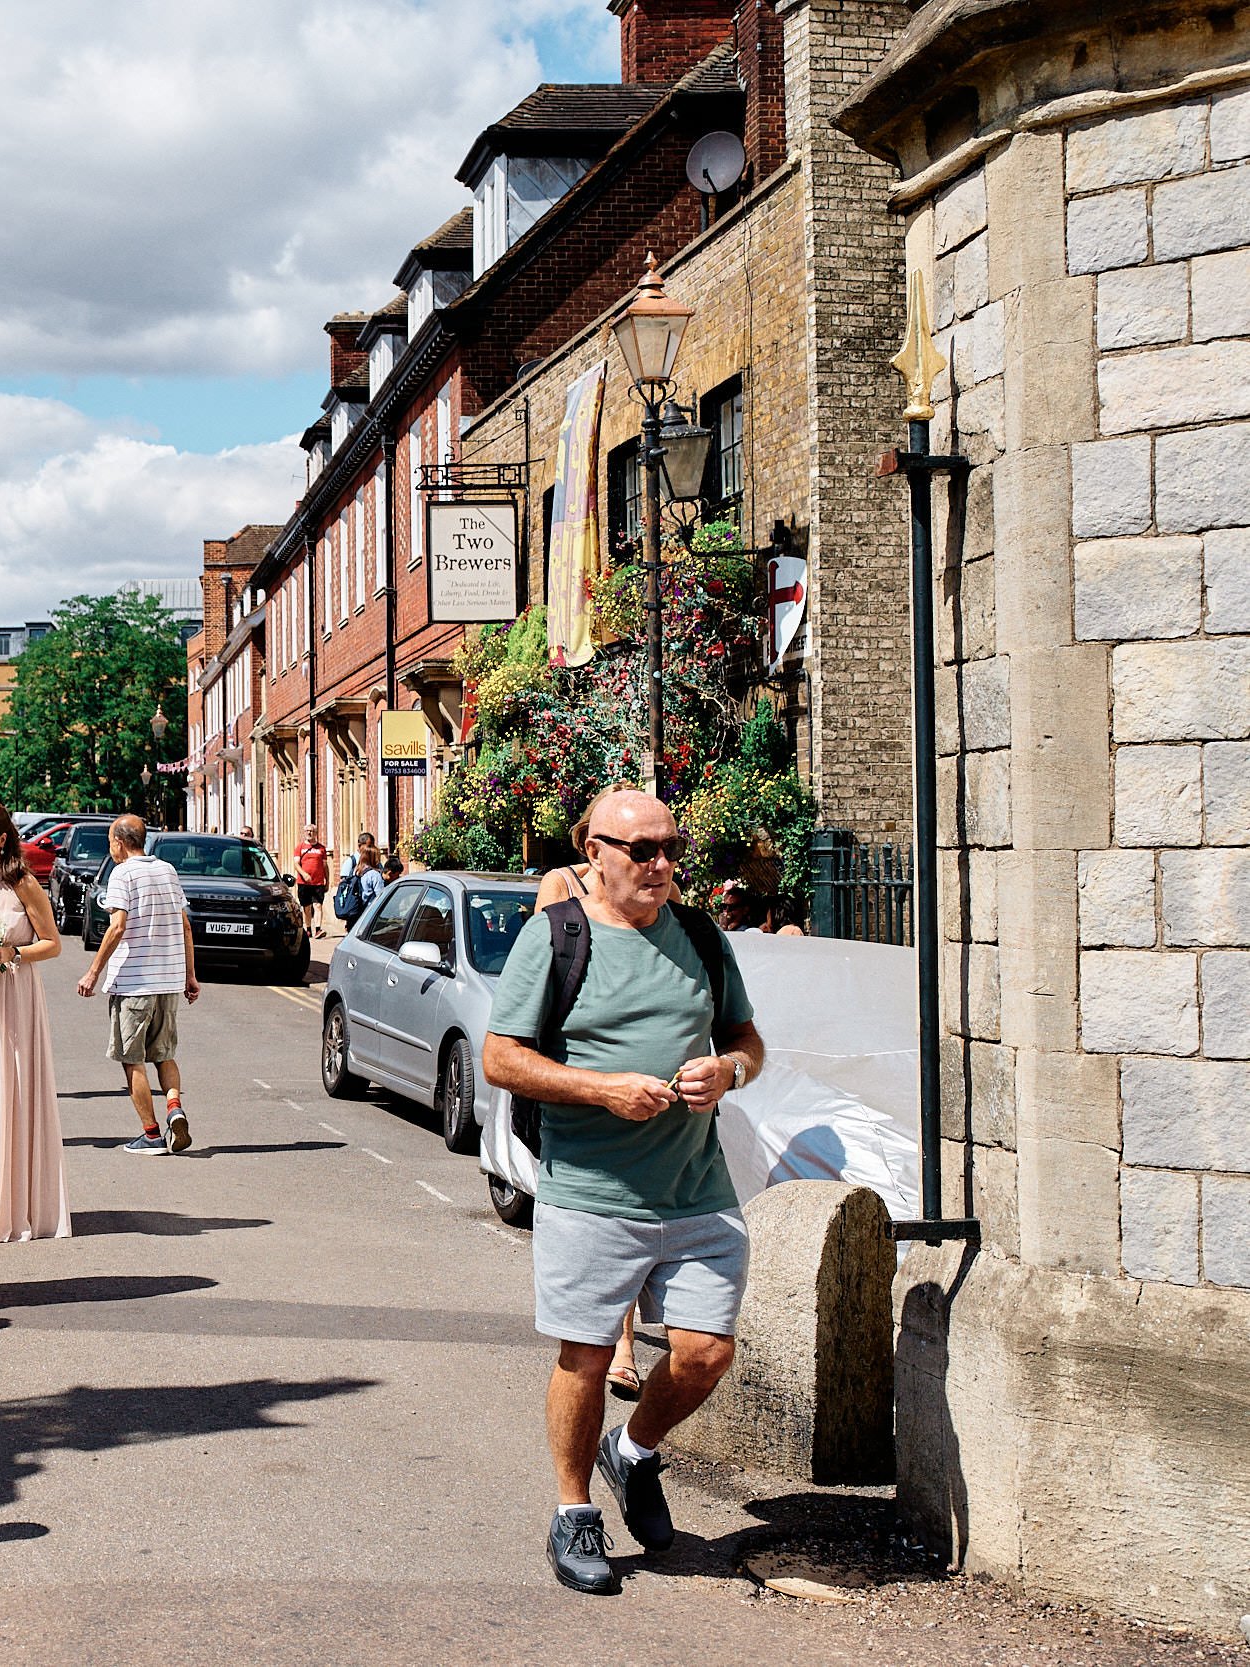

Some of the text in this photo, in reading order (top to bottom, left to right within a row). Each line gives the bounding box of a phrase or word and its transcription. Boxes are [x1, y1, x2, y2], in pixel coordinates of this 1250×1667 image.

[459, 518, 485, 530] The
[452, 533, 494, 550] Two
[434, 554, 512, 571] Brewers
[384, 741, 427, 756] savills
[209, 923, 251, 934] VU67 JHE
